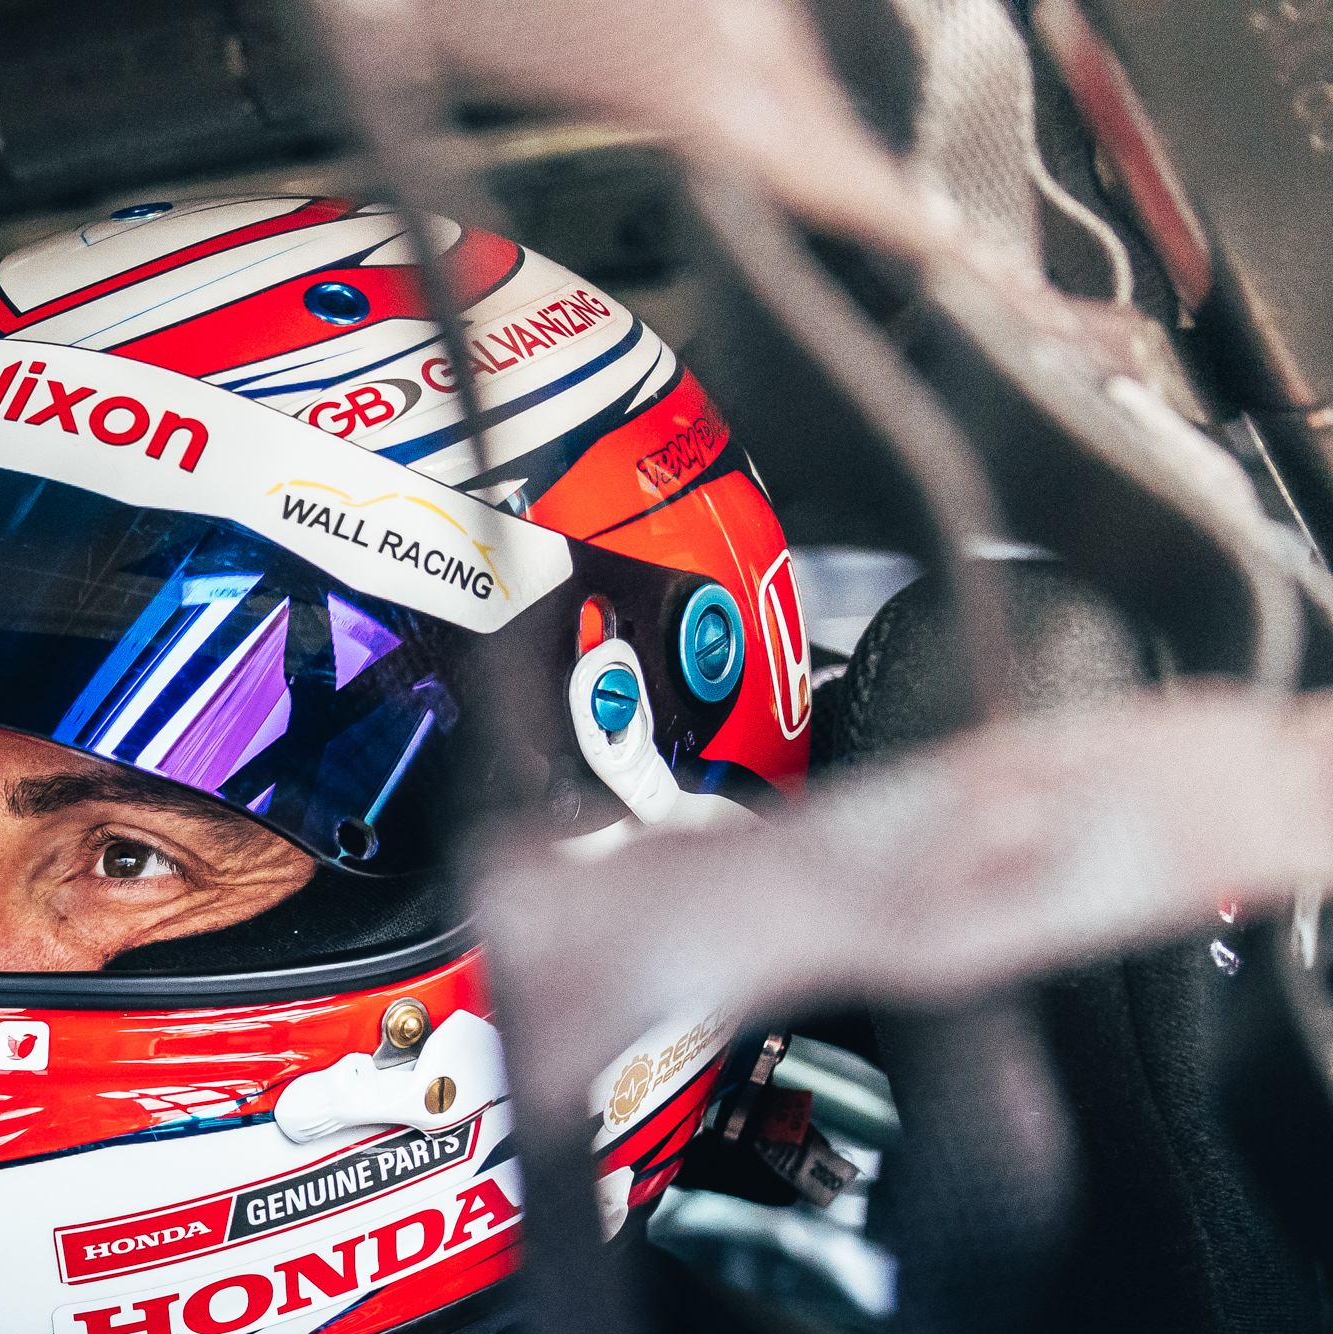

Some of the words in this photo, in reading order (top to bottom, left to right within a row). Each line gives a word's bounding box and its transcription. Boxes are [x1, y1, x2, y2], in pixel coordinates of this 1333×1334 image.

[308, 386, 395, 438] GB
[282, 495, 369, 548] WALL
[378, 530, 494, 599] RACING
[84, 1220, 212, 1261] HONDA
[246, 1159, 374, 1227] GENUINE
[379, 1131, 462, 1183] PARTS
